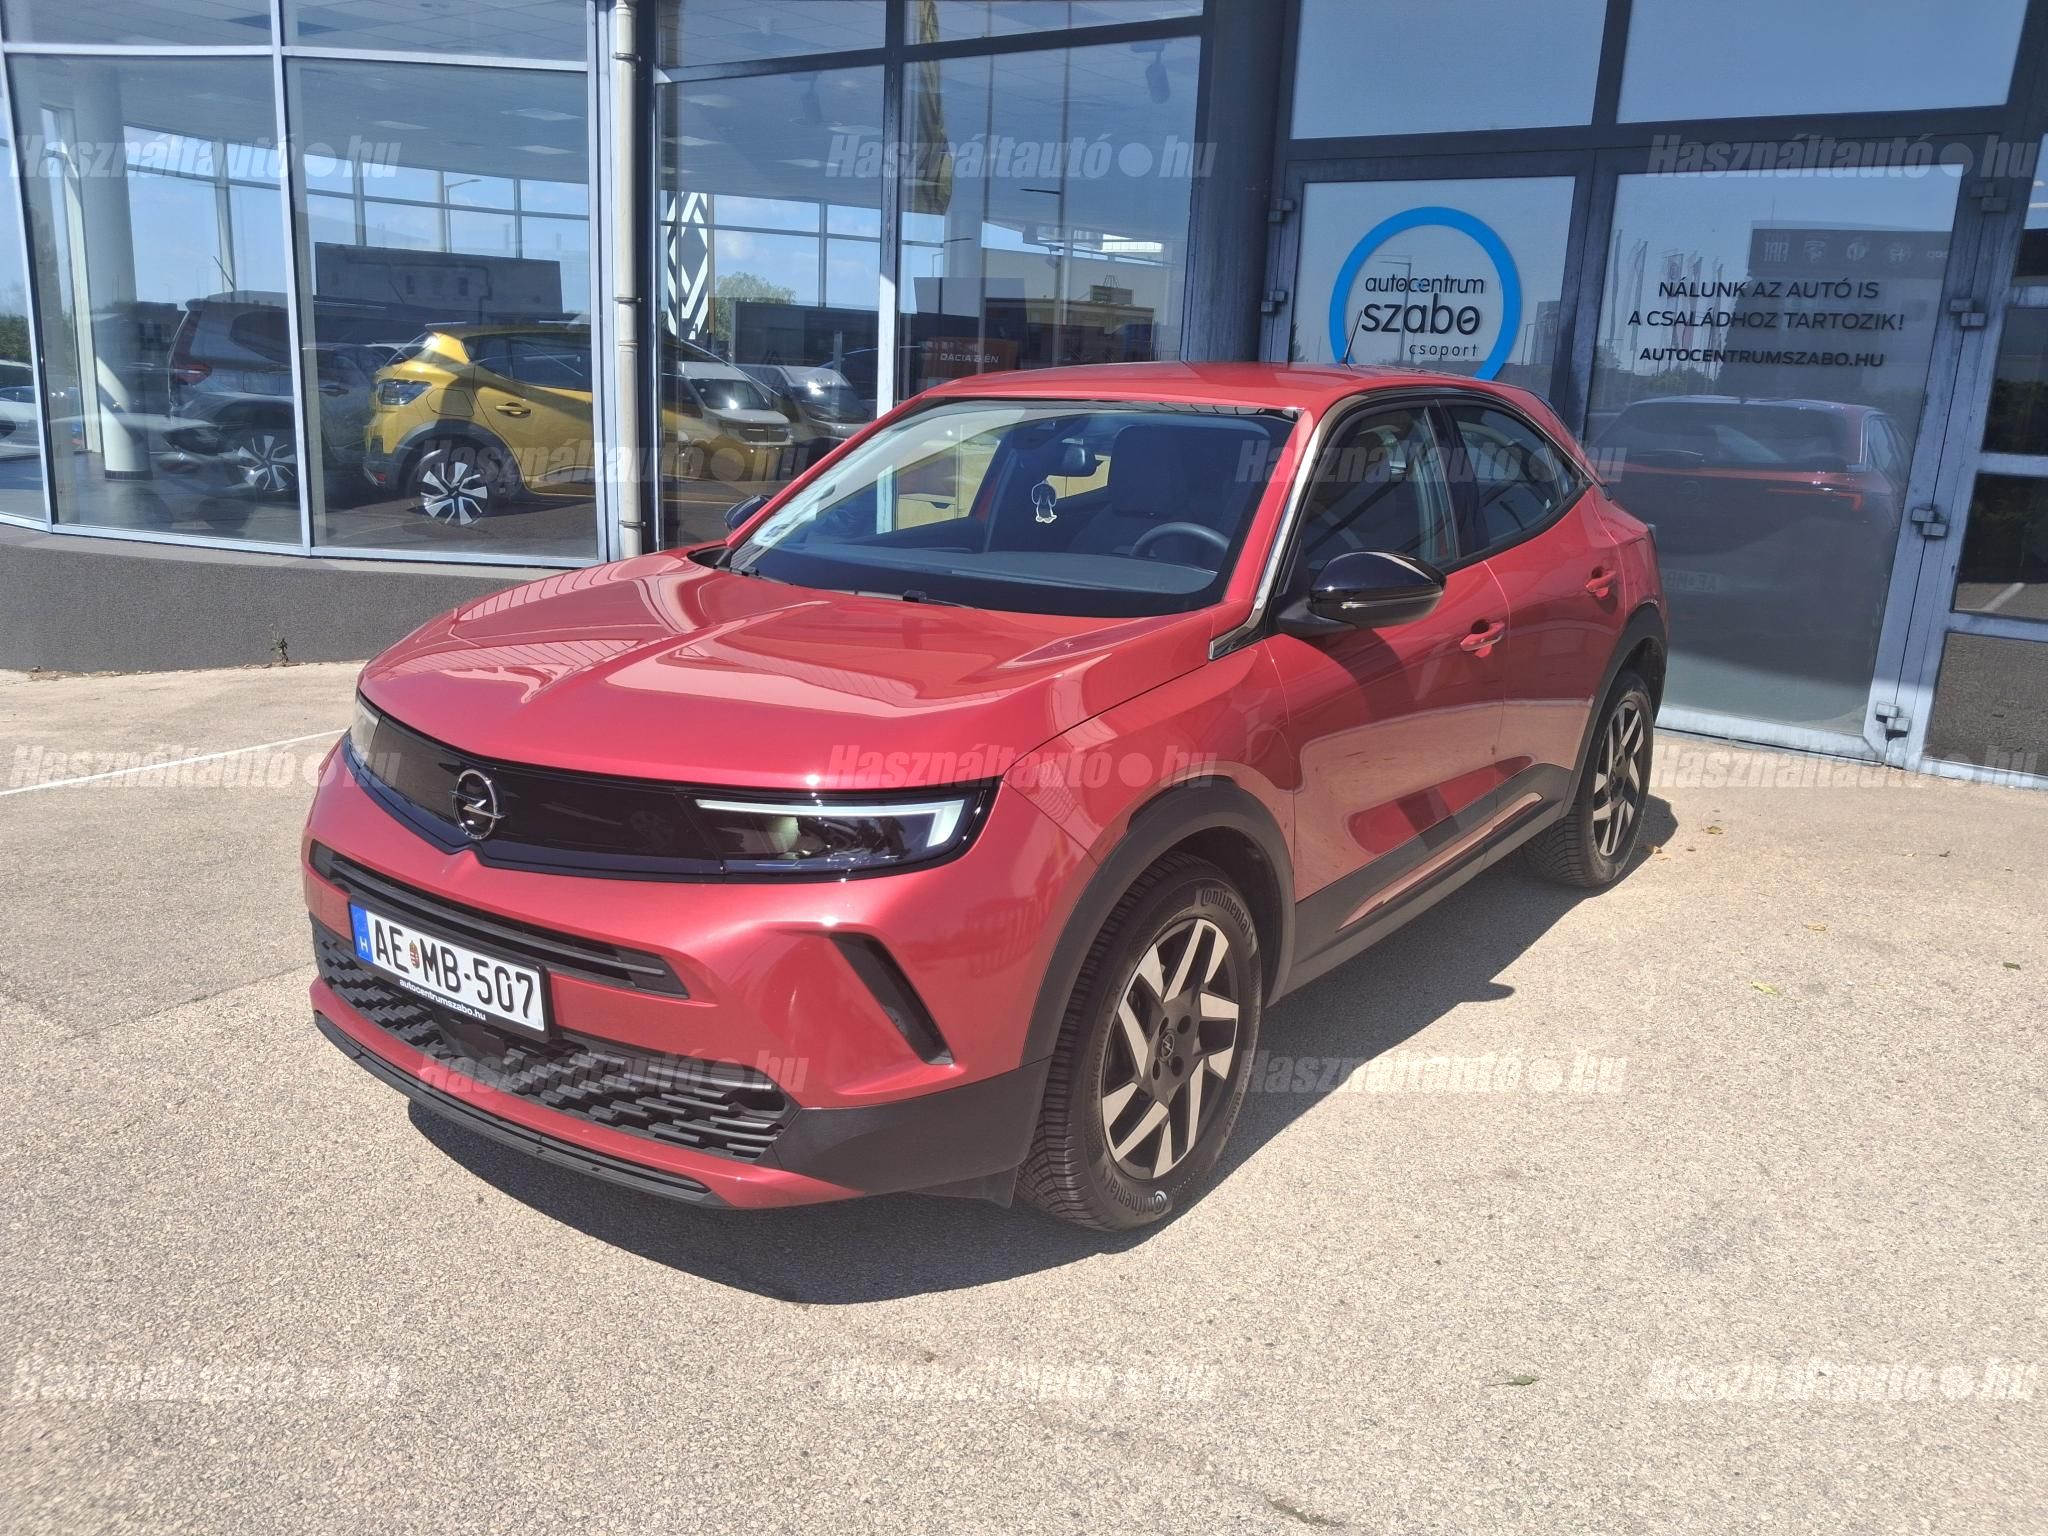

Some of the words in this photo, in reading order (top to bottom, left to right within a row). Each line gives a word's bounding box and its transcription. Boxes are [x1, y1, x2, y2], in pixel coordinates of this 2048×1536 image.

[1365, 274, 1485, 294] autocentrum
[1658, 276, 1748, 298] NÁLUNK
[1752, 281, 1783, 299] AZ
[1786, 277, 1853, 299] AUTÓ
[1857, 281, 1880, 299] IS
[1628, 310, 1642, 327] A
[1646, 307, 1779, 330] CSALÁDHOZ
[1784, 312, 1905, 331] TARTOZIK!
[940, 352, 972, 363] DACIA
[1409, 344, 1478, 361] csoport
[1639, 347, 1885, 368] AUTOCENTRUMSZABO.HU
[359, 936, 369, 953] H
[374, 919, 410, 975] AE
[399, 978, 488, 1022] autocentrumszabo.hu
